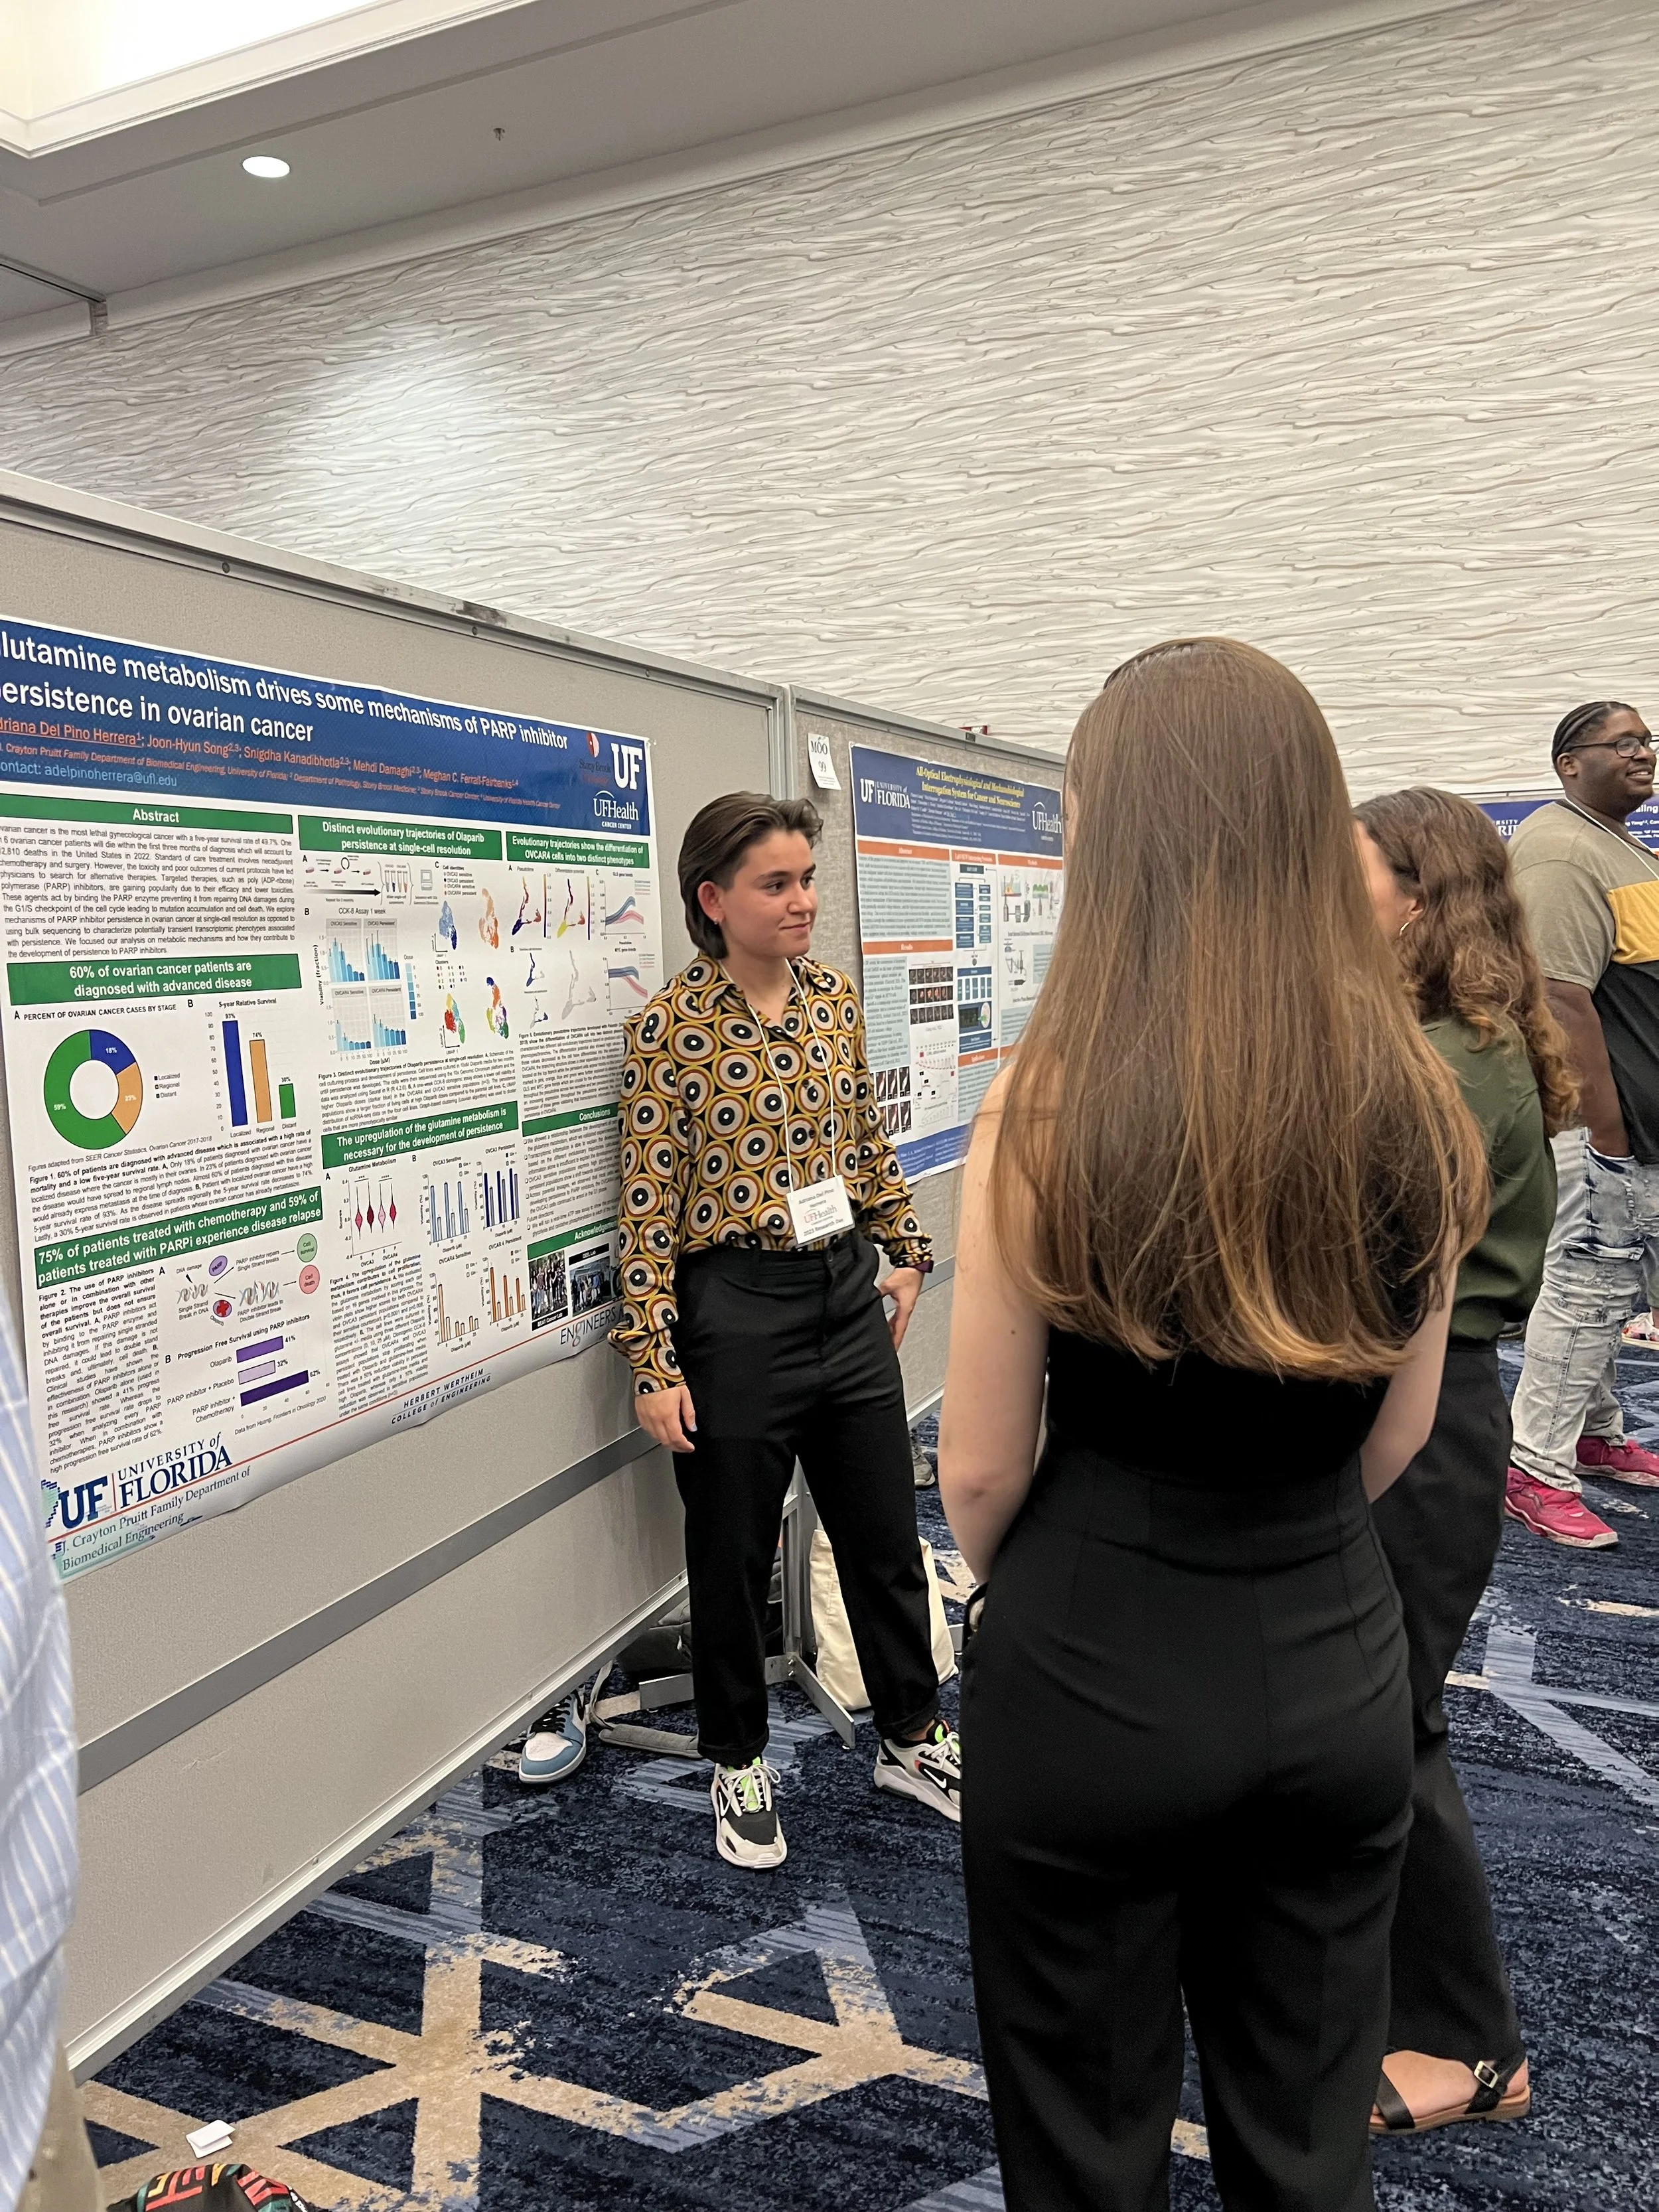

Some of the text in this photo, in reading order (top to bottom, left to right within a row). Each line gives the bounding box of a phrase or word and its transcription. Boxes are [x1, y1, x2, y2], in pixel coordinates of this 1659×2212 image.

[0, 630, 567, 749] lutamine metabolism drives some mechanisms of PARP inhibitor
[0, 682, 313, 741] ersistence in ovarian cancer
[0, 718, 36, 734] driana
[40, 721, 60, 737] Del
[64, 725, 90, 740] Pino
[147, 735, 200, 753] Joon-Hyun
[244, 747, 281, 762] Snigdha
[353, 760, 378, 773] Mehdi
[423, 769, 451, 782] Meghan
[452, 773, 459, 782] C.
[0, 762, 41, 774] ontact:
[611, 743, 642, 790] UF
[916, 766, 940, 780] All-Optical
[860, 778, 874, 803] UF
[876, 782, 902, 792] UNIVERSITY
[922, 781, 952, 796] Interrogation
[952, 786, 967, 800] System
[974, 792, 988, 802] Cancer
[593, 798, 638, 820] UFHealth
[877, 790, 910, 808] FLORIDA
[132, 808, 180, 824] Abstract
[1032, 810, 1062, 834] UFHealth
[322, 821, 484, 844] Distinct evolutionary trajectories of Olaparib
[512, 836, 604, 851] Evolutionary trajectories show the
[341, 839, 471, 855] persistence at single-cell resolution
[524, 849, 551, 859] OVCAR4
[551, 851, 564, 860] cells
[565, 852, 576, 861] into
[576, 853, 587, 862] two
[587, 853, 607, 863] distinct
[3, 893, 22, 901] These
[24, 893, 48, 903] agents
[63, 893, 72, 903] by
[74, 893, 98, 903] binding
[69, 961, 252, 979] 60% of ovarian cancer patients are
[74, 978, 252, 997] diagnosed with advanced disease
[187, 999, 194, 1008] B
[14, 1010, 20, 1020] A
[23, 1011, 56, 1020] PERCENT
[579, 1109, 611, 1121] Conclusions
[336, 1107, 506, 1147] The upregulation of the glutamine metabolism is
[343, 1120, 504, 1161] necessary for the development of persistence
[38, 1191, 319, 1264] 75% of patients treated with chemotherapy and 59% of
[38, 1208, 321, 1287] patients treated with PARPi experience disease relapse
[177, 1345, 213, 1361] Progression
[228, 1331, 252, 1343] Survival
[253, 1327, 268, 1336] using
[269, 1321, 285, 1331] PARP
[286, 1314, 310, 1326] inhibitors
[285, 1335, 296, 1343] 41%
[310, 1370, 321, 1378] 62%
[403, 1368, 484, 1408] HERBERT WERTHEIM
[392, 1376, 491, 1424] COLLEGE of ENGINEERING
[117, 1432, 222, 1481] UNIVERSITY of
[119, 1445, 233, 1509] FLORIDA
[59, 1475, 108, 1529] UF
[72, 1465, 251, 1548] Crayton Pruitt Family Department of
[63, 1513, 184, 1571] Biomedical Engineering
